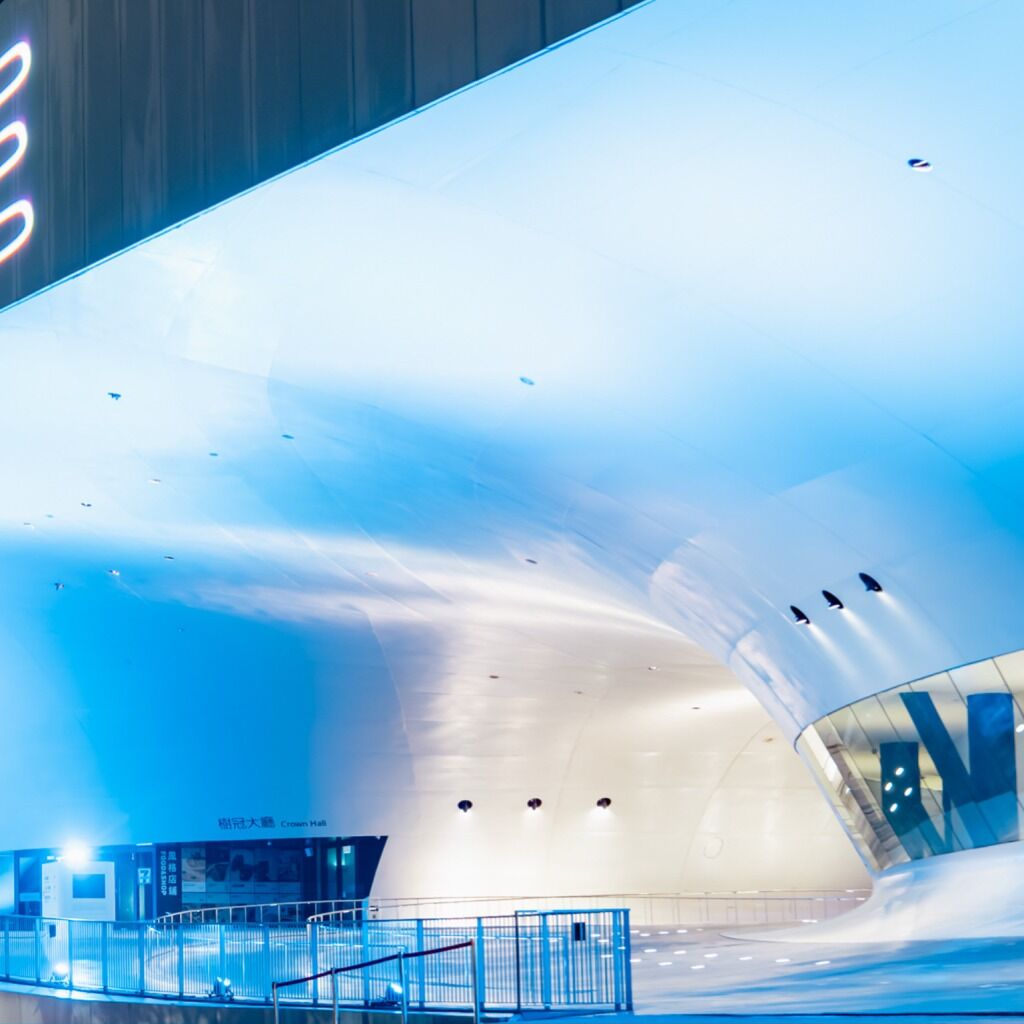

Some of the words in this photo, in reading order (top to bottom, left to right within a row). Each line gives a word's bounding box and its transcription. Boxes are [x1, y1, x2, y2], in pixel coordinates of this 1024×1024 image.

[218, 816, 275, 830] 樹冠大廳
[280, 820, 308, 828] Crown
[310, 819, 327, 828] Hall
